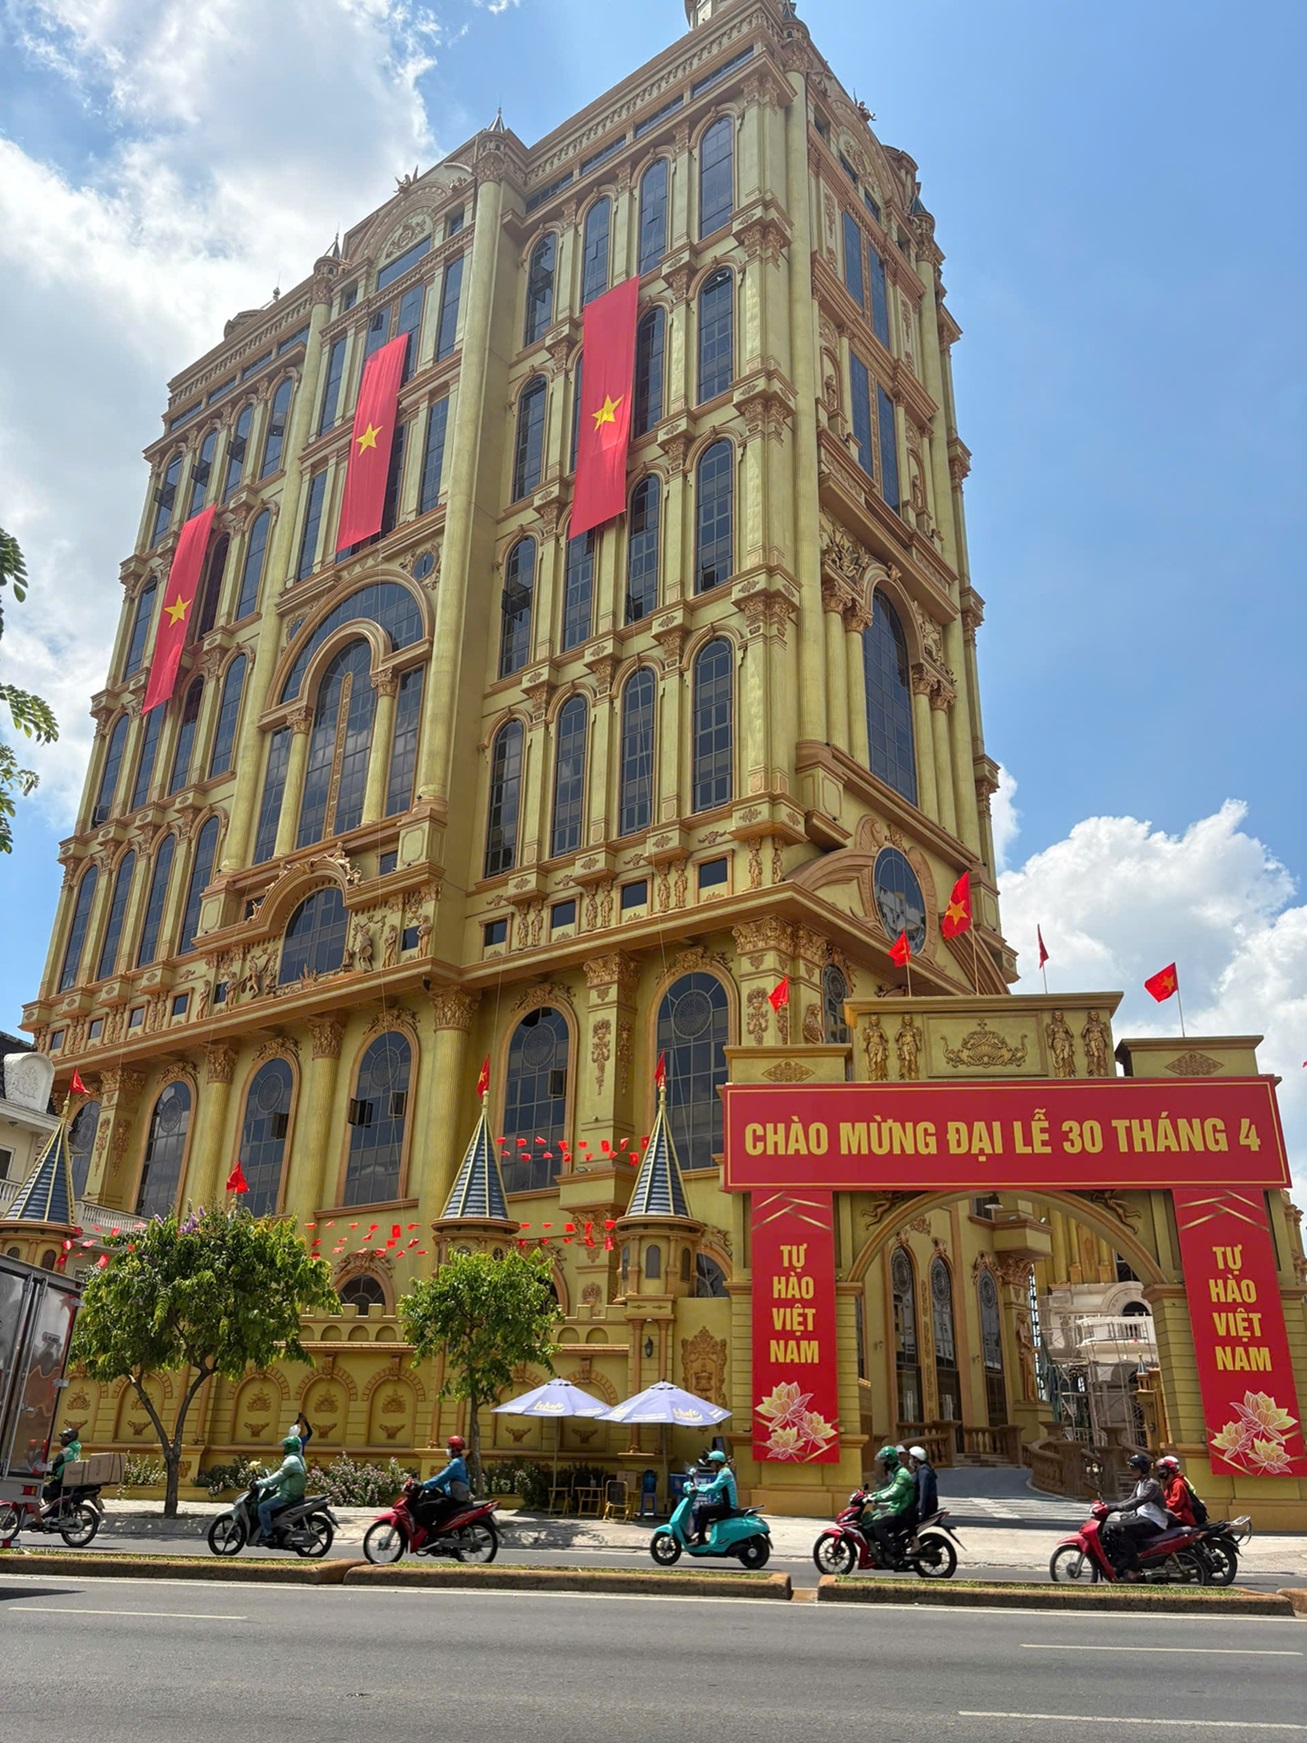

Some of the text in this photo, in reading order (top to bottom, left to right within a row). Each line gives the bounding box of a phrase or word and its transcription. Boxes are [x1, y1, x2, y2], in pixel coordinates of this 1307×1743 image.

[745, 1108, 1261, 1162] CHÀO MỪNG ĐẠI LỄ 30 THÁNG 4
[779, 1243, 808, 1274] TỰ
[1212, 1244, 1242, 1276] TỰ
[772, 1271, 814, 1300] HÀO
[1208, 1275, 1257, 1304] HÀO
[772, 1303, 816, 1338] VIỆT
[1212, 1307, 1262, 1343] VIỆT
[769, 1340, 819, 1364] NAM
[1214, 1346, 1272, 1372] NAM
